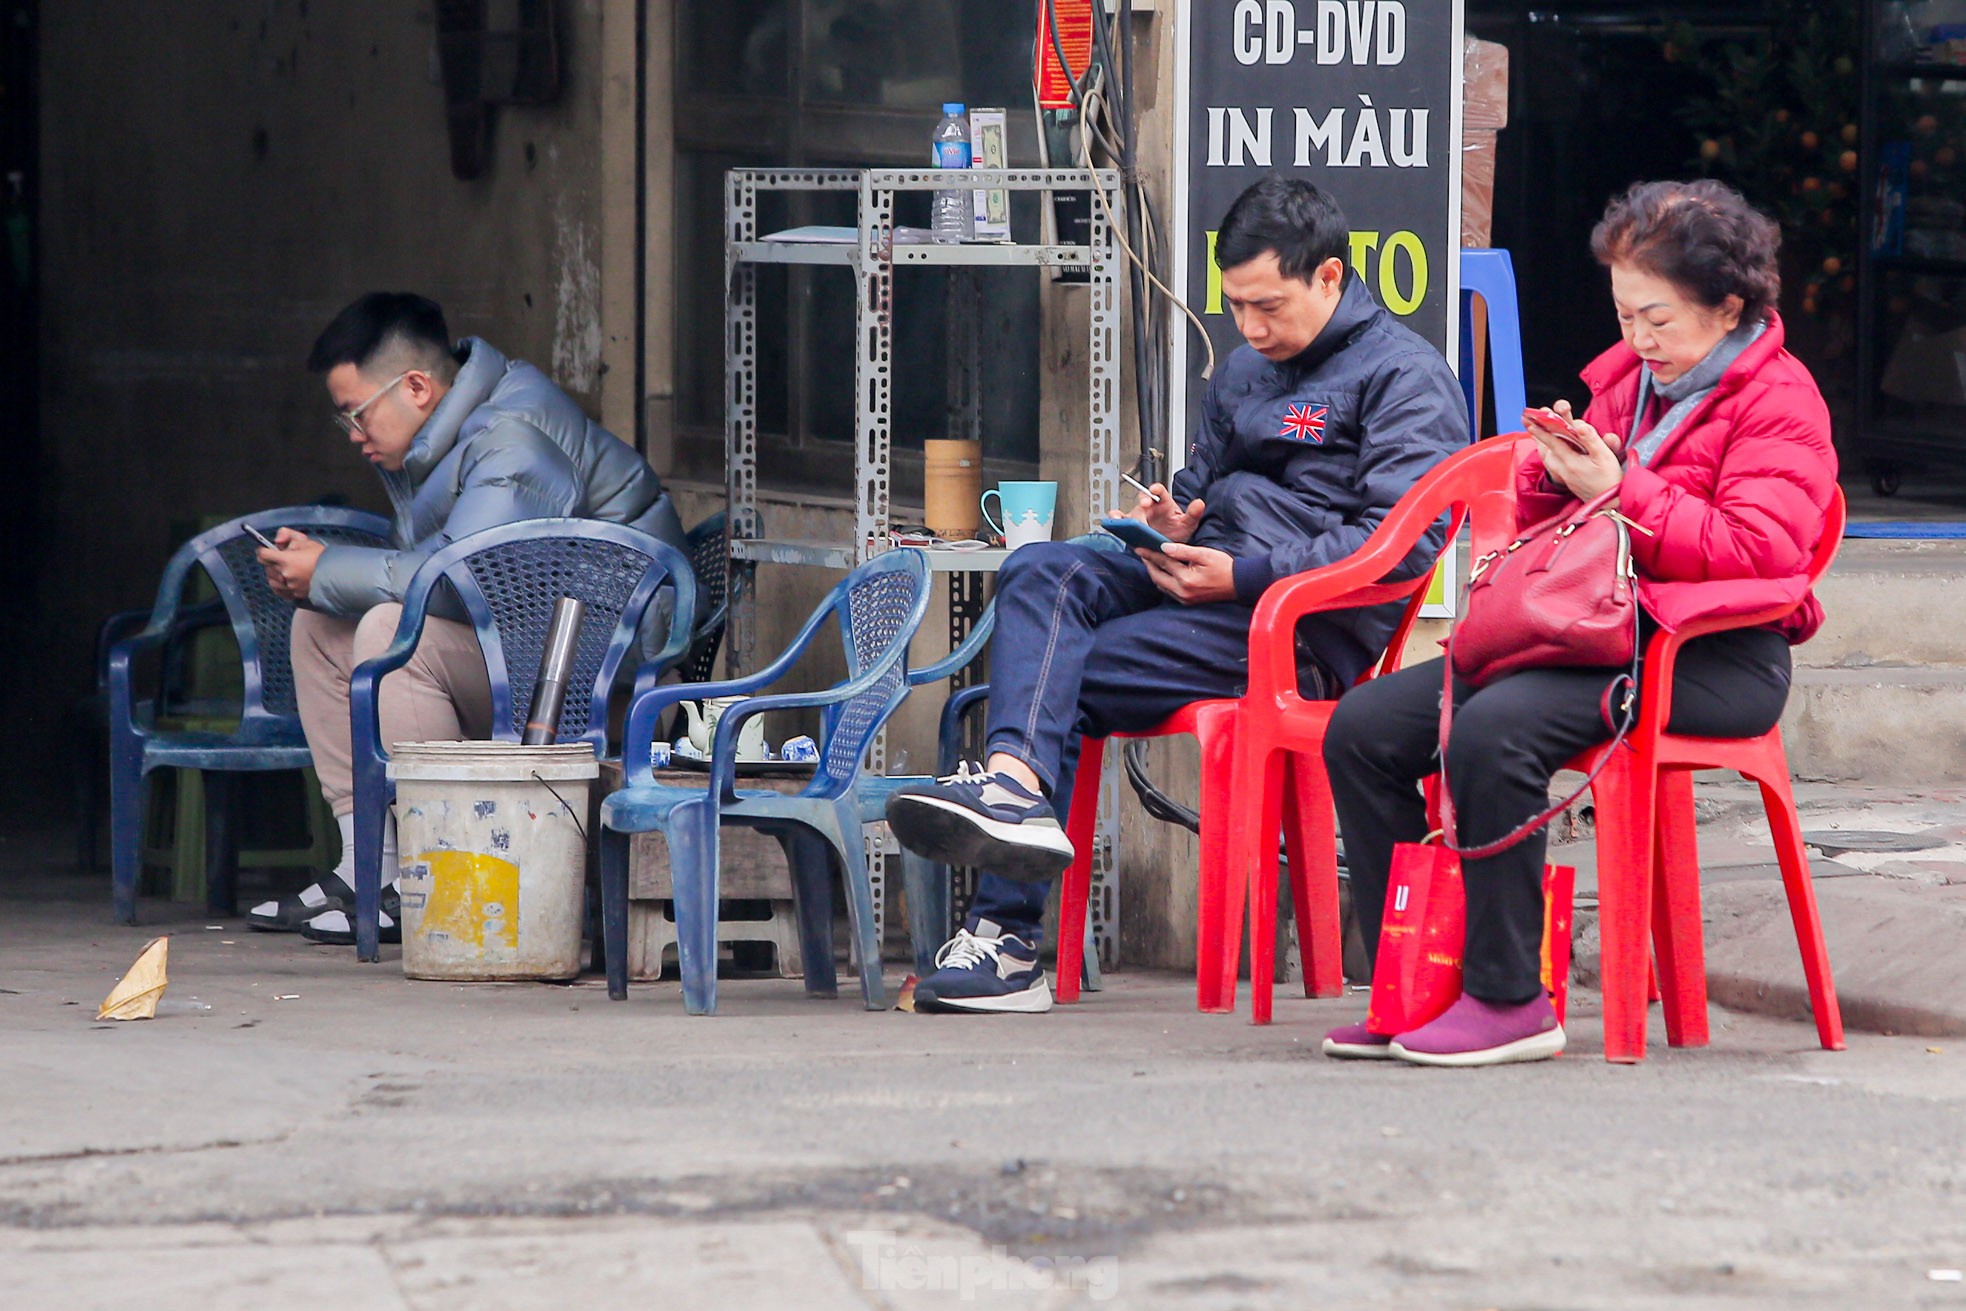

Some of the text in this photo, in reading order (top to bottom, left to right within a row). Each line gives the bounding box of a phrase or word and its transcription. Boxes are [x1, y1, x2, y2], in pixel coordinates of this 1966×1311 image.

[1233, 0, 1406, 65] CD-DVD
[1206, 94, 1429, 167] IN MÀU
